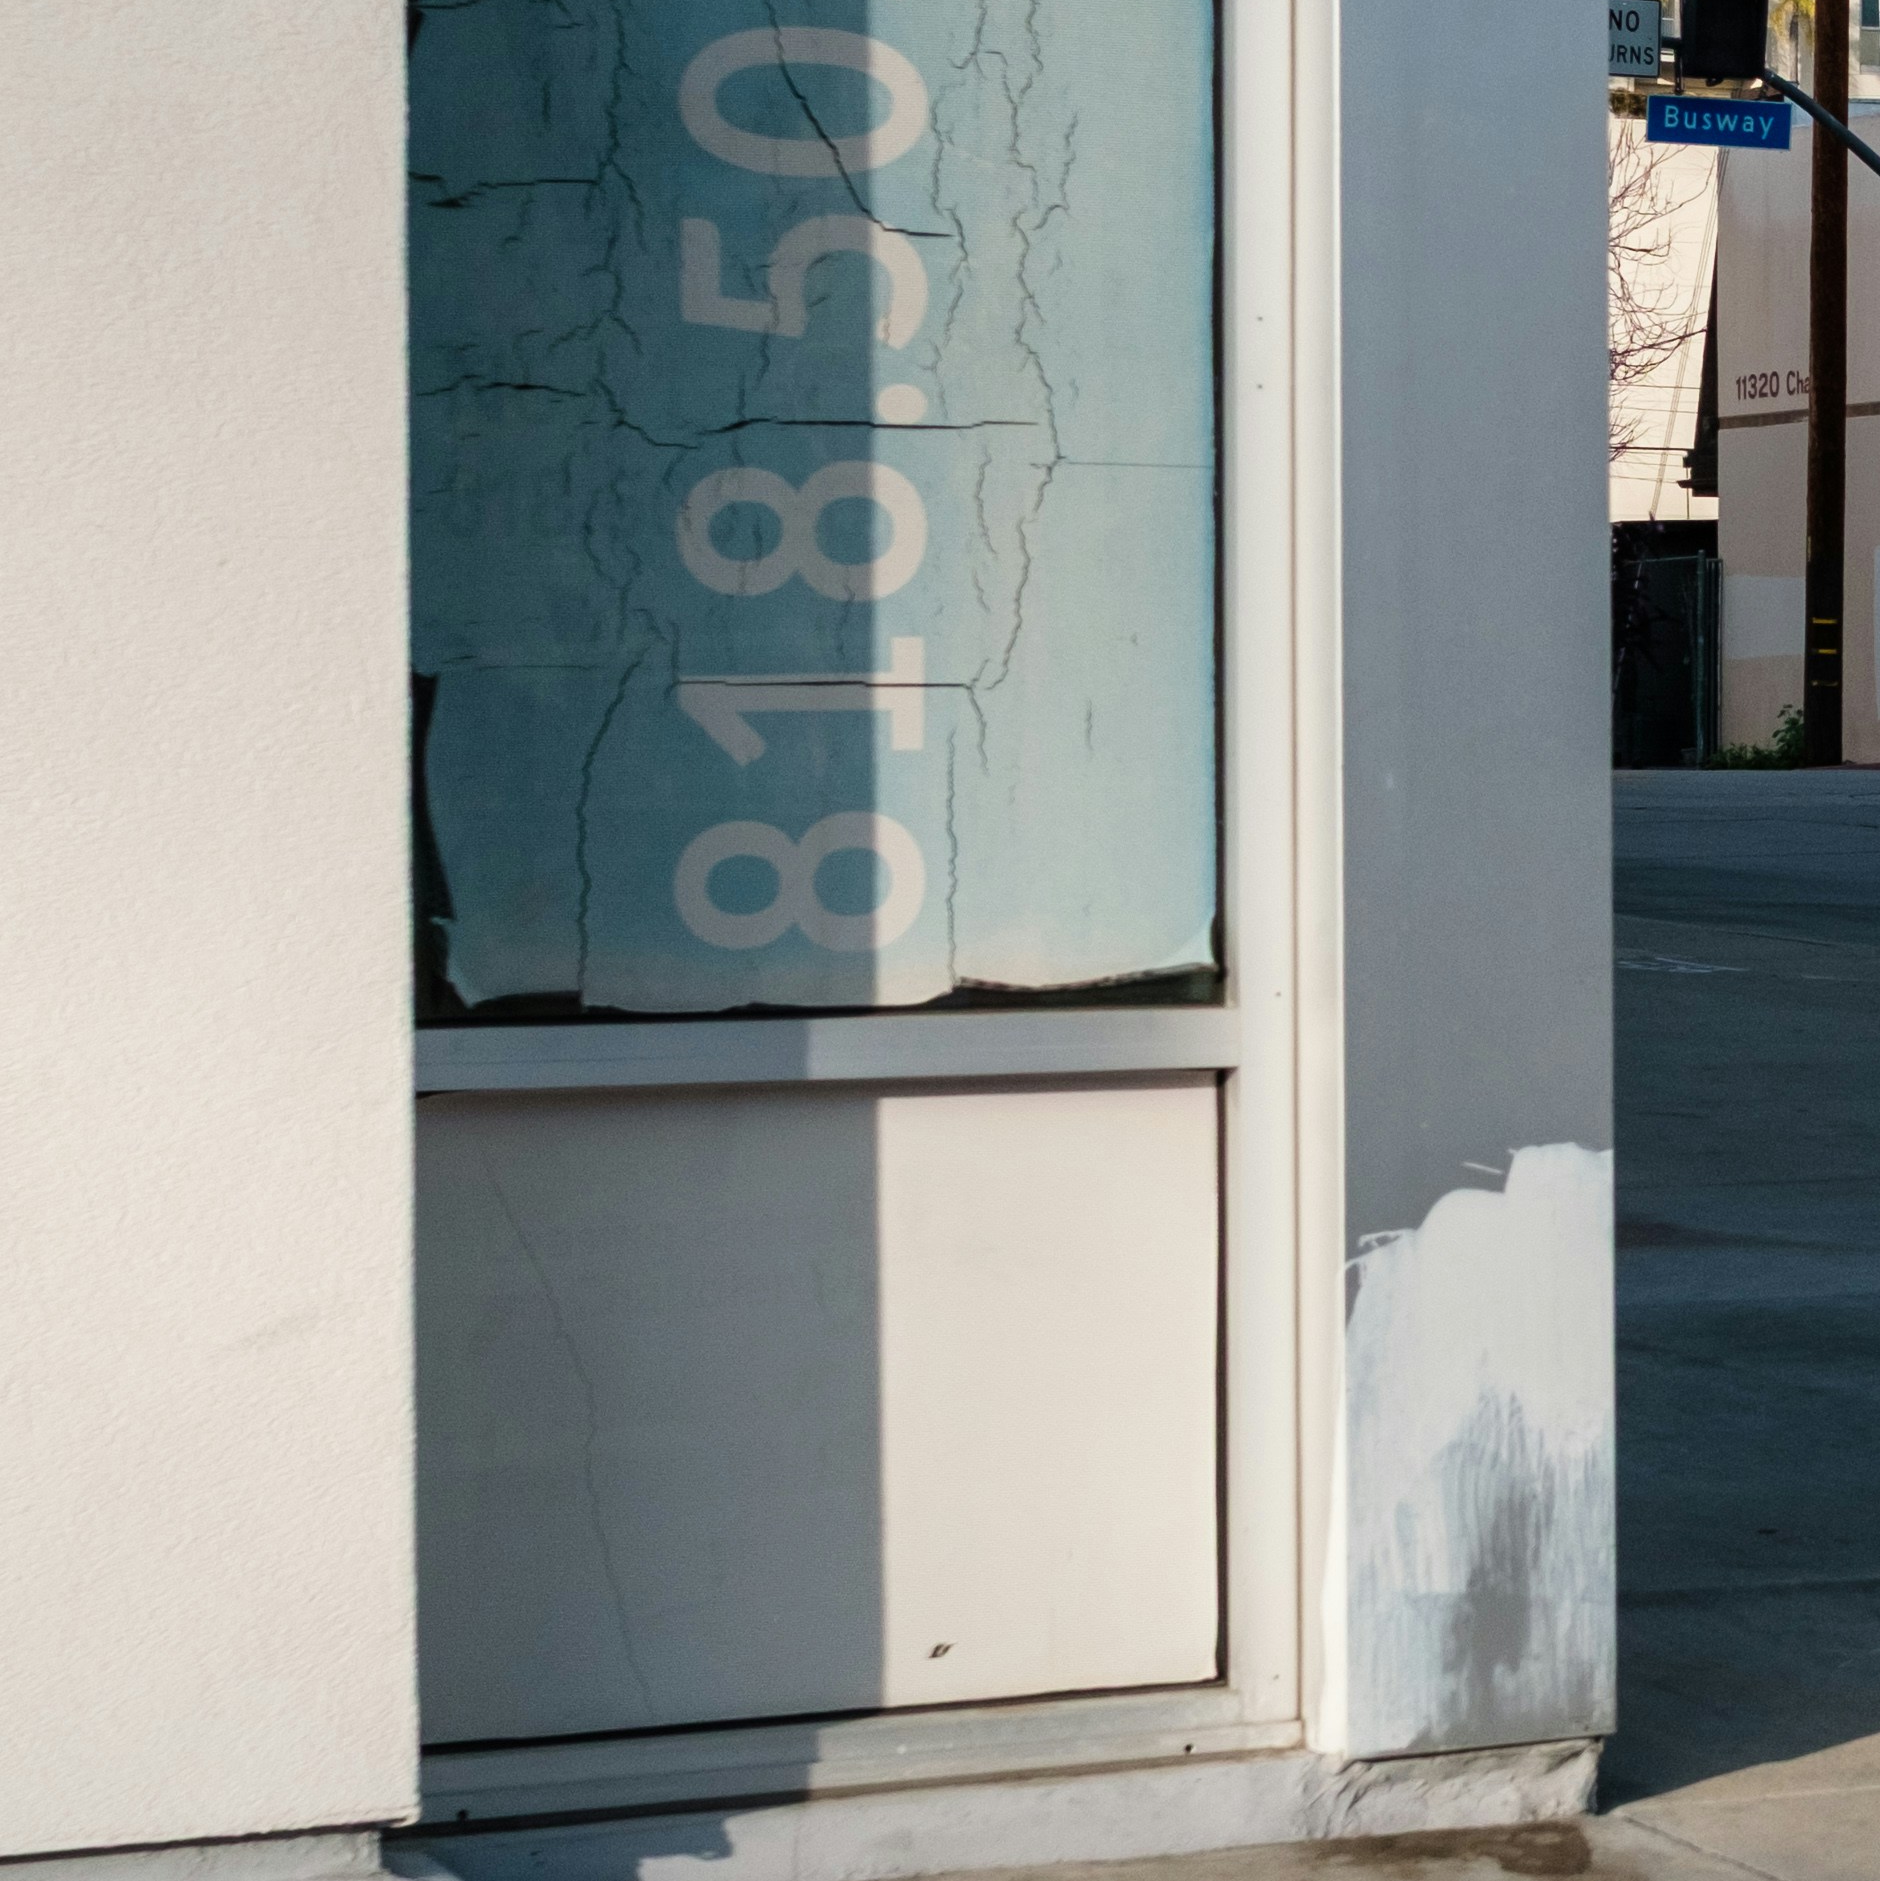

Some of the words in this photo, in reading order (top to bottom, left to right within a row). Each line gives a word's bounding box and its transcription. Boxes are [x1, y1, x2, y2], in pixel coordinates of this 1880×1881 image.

[1609, 10, 1639, 32] NO
[1609, 45, 1654, 65] URNS
[1664, 105, 1774, 140] Busway
[1736, 371, 1779, 400] 11320
[1786, 370, 1810, 395] Cha
